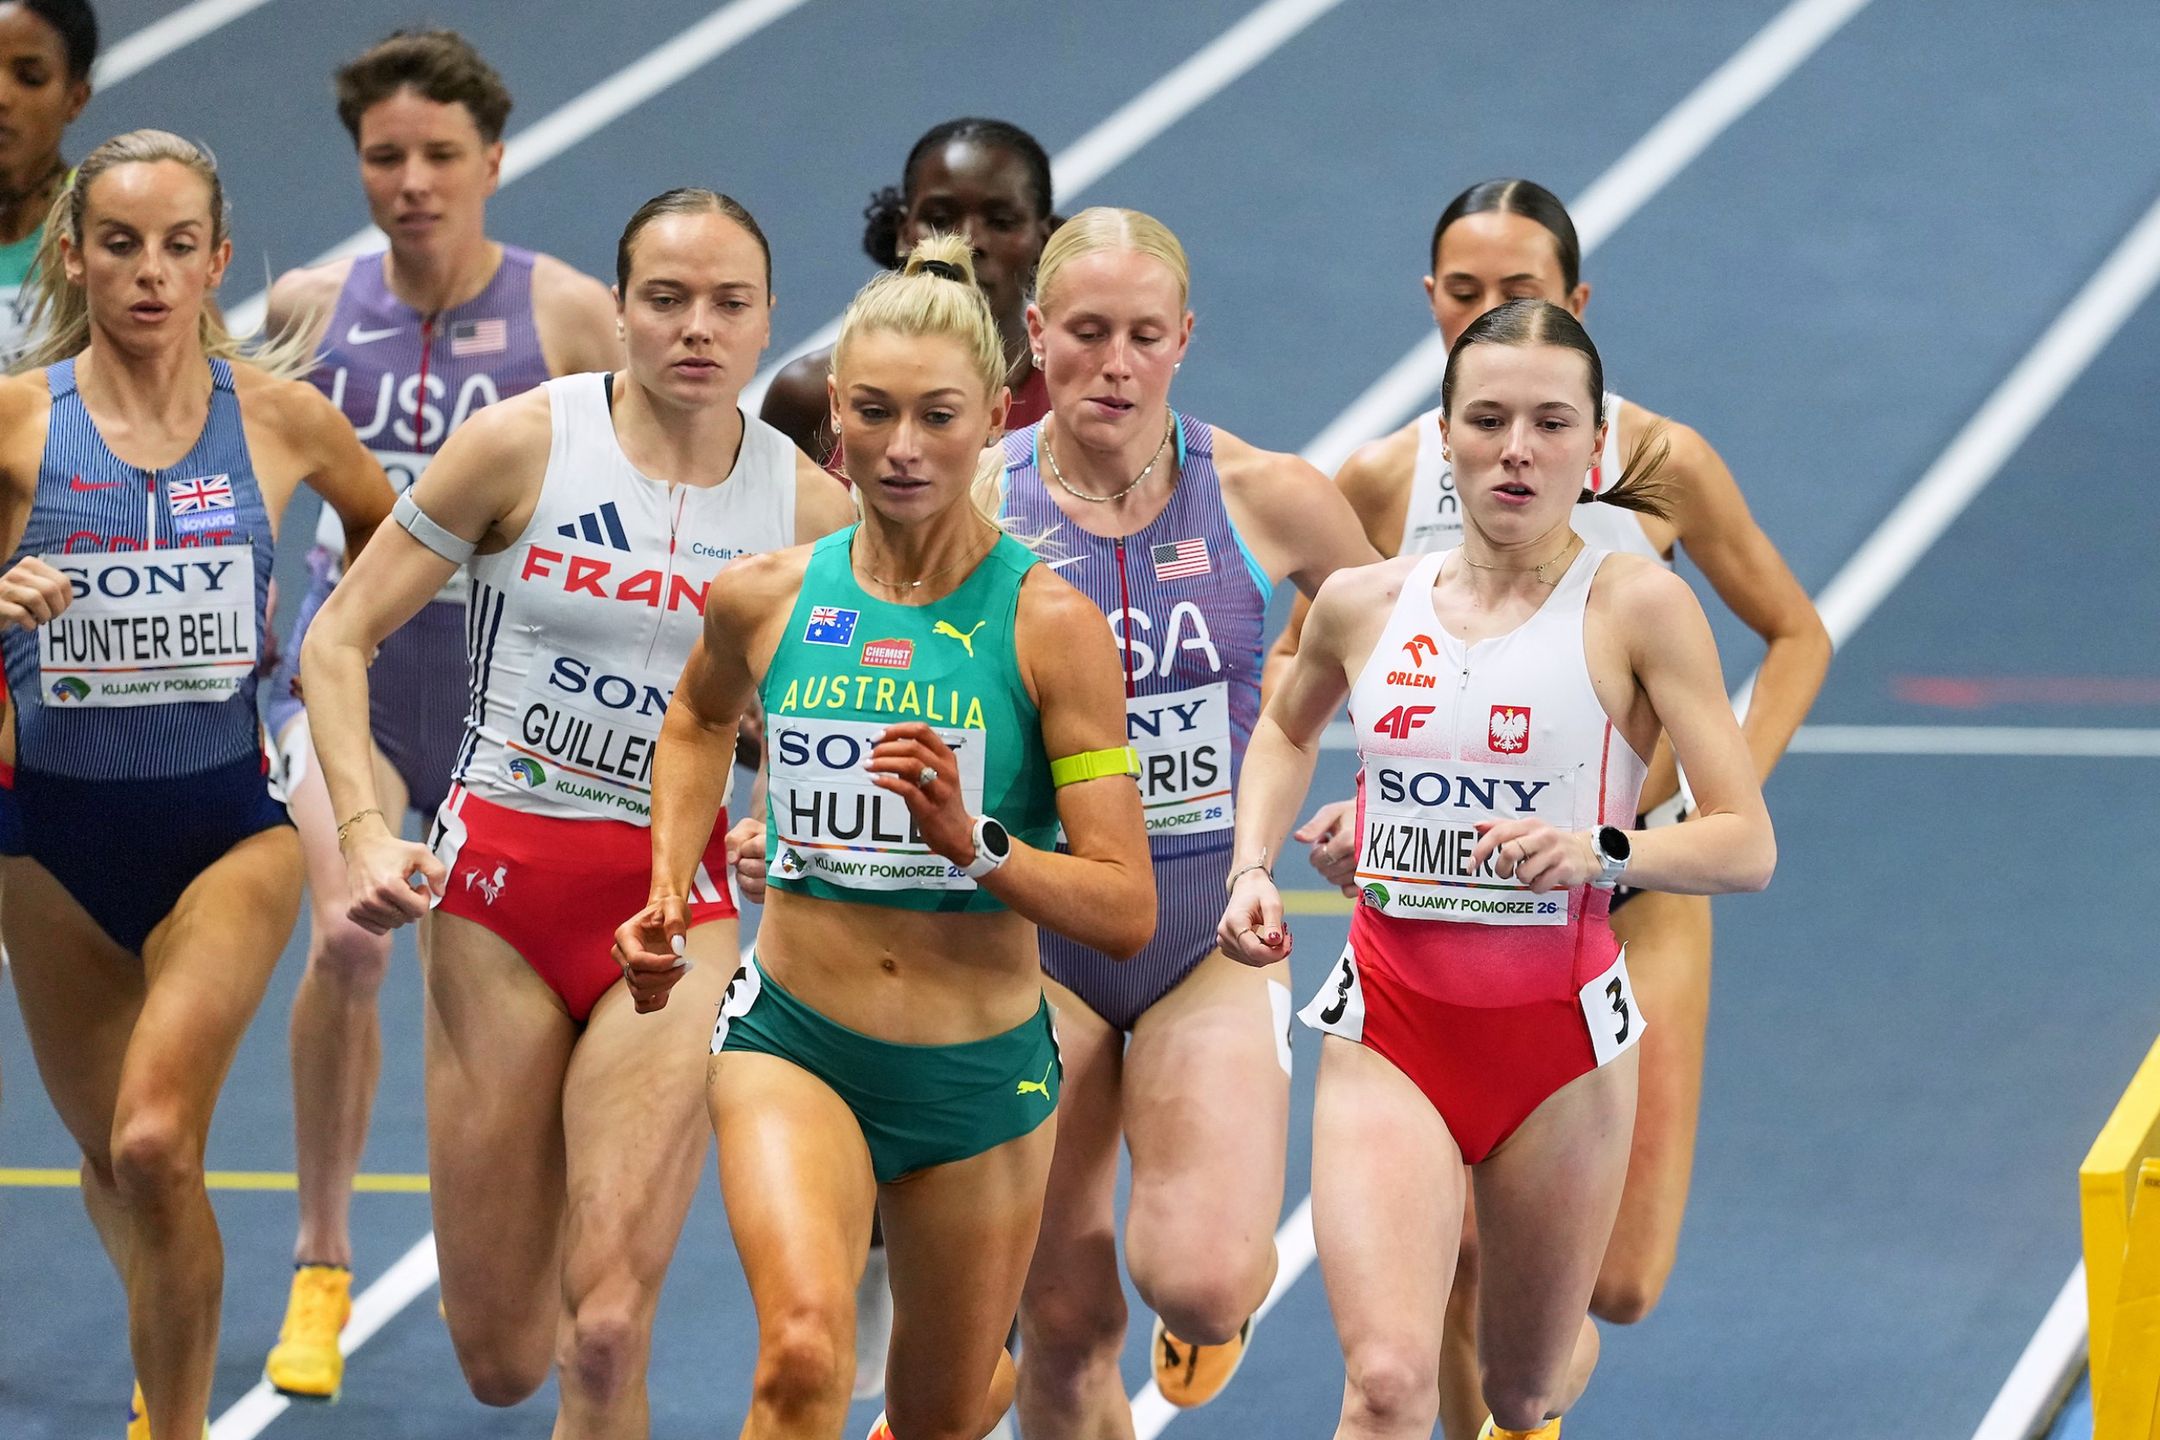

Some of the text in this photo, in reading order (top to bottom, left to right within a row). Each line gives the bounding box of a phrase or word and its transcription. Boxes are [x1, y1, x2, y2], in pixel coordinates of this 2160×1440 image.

[331, 366, 498, 447] USA
[177, 512, 236, 532] Novuna
[692, 542, 732, 560] Crédit
[61, 561, 233, 599] SONY
[521, 544, 712, 617] FRAN
[49, 610, 249, 663] HUNTER BELL
[865, 646, 910, 660] CHEMIST
[1107, 600, 1222, 683] SA
[101, 681, 161, 696] KUJAWY
[164, 678, 232, 692] POMORZE
[549, 656, 674, 717] SON
[1386, 671, 1437, 689] ORLEN
[779, 675, 986, 731] AUSTRALIA
[1127, 699, 1208, 741] NY
[1373, 705, 1437, 739] 4F
[522, 702, 655, 785] GUILLE
[1140, 745, 1219, 798] RIS
[1379, 769, 1550, 812] SONY
[555, 780, 651, 818] KUJAWY POM
[1145, 807, 1223, 832] OMORZE 26
[815, 856, 867, 876] KUJAWY
[870, 863, 945, 878] POMORZE
[1398, 893, 1557, 914] KUJAWY POMORZE 26
[1320, 957, 1355, 1025] 3
[1605, 975, 1630, 1045] 3
